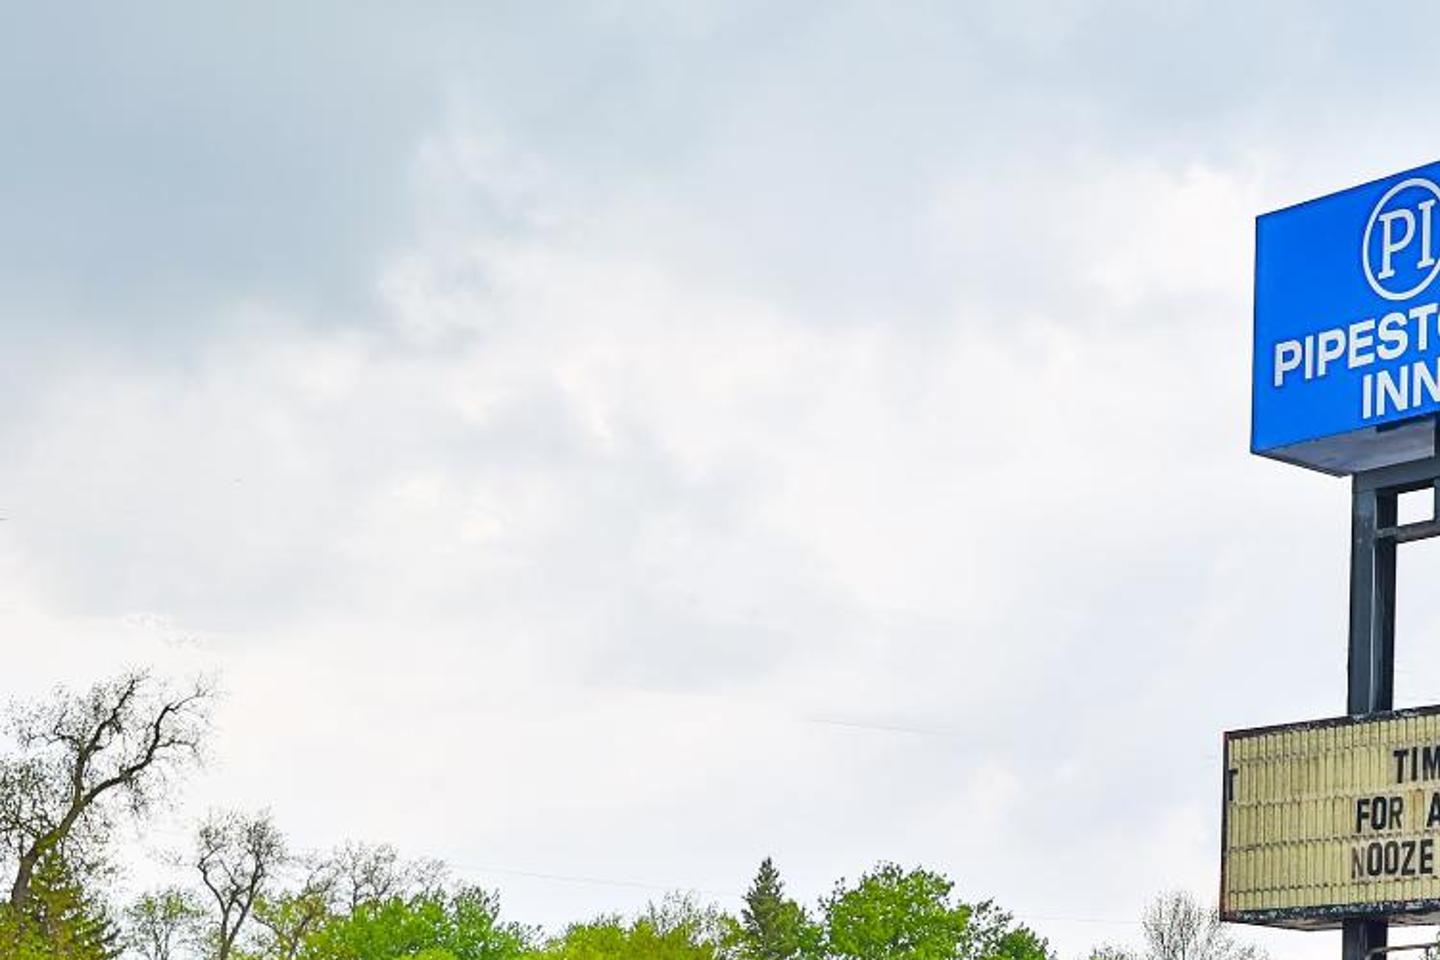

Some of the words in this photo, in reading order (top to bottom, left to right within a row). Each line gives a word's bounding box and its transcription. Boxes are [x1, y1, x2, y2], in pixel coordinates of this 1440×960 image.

[1377, 198, 1437, 281] PI
[1356, 795, 1403, 834] FOR
[1351, 838, 1434, 880] NOOZE
